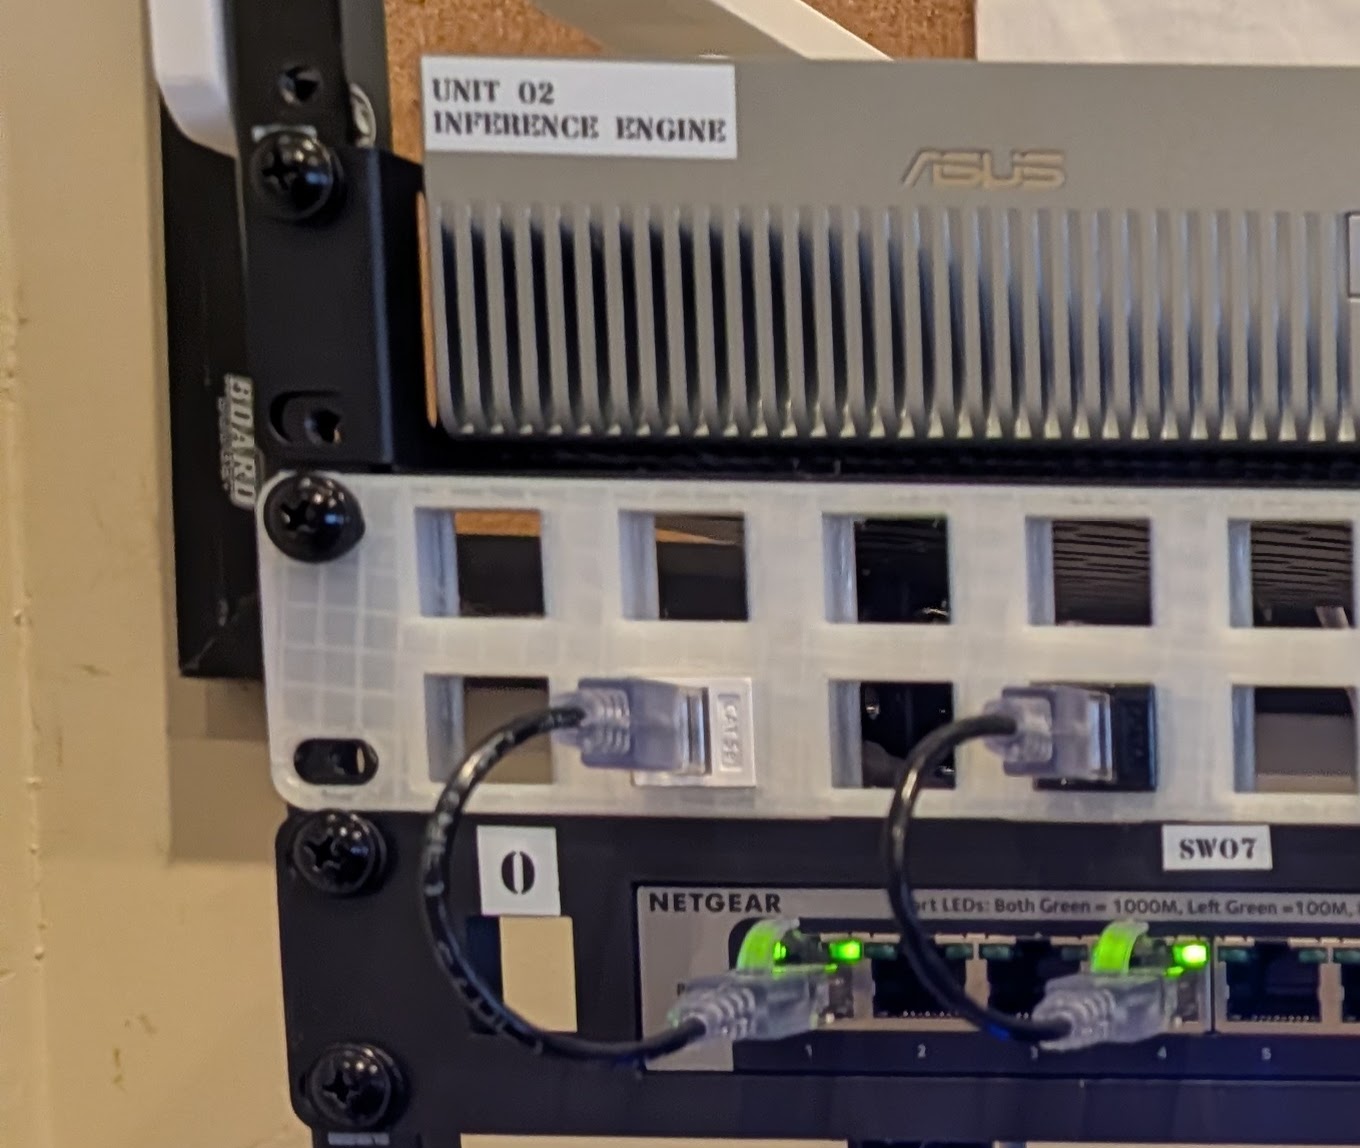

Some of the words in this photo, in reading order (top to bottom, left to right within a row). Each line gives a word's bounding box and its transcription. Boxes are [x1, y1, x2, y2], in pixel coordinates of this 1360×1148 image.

[432, 78, 499, 103] UNIT
[519, 81, 554, 104] 02
[433, 111, 599, 139] INFERENCE
[616, 117, 727, 142] ENGINE
[901, 147, 1065, 189] ASUS
[649, 893, 782, 913] NETGEAR
[995, 898, 1035, 913] Both
[1040, 899, 1091, 914] Green
[1188, 899, 1220, 915] Left
[1227, 900, 1278, 916] Green
[917, 1044, 926, 1059] 2
[1157, 1046, 1168, 1060] 4
